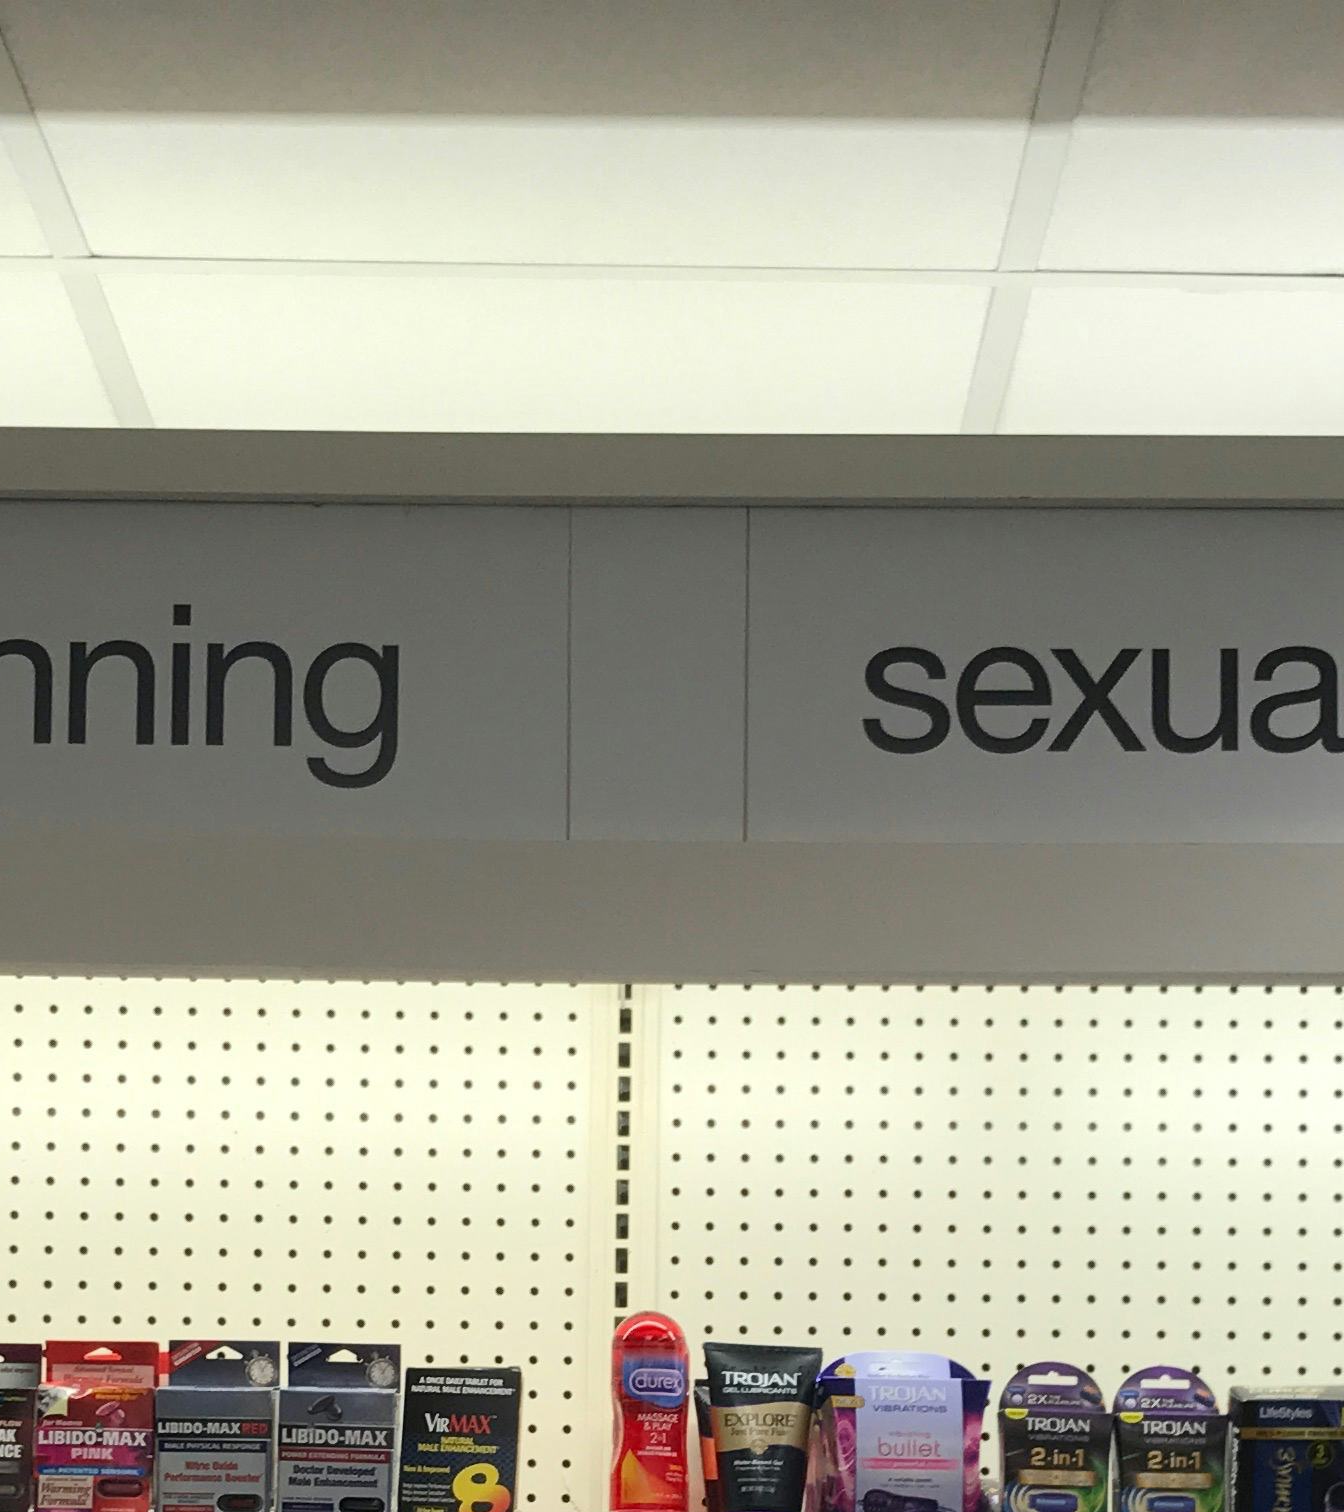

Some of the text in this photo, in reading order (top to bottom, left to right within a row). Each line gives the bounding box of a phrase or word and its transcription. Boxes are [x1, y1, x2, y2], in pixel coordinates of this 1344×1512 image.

[635, 1373, 683, 1390] durex
[721, 1371, 798, 1387] TROJAN
[869, 1386, 946, 1402] TROJAN
[872, 1404, 947, 1414] VIBRATIONS
[1259, 1407, 1313, 1420] LifeStyles
[725, 1413, 794, 1428] EXPLORE
[1026, 1417, 1090, 1434] TROJAN
[1141, 1420, 1206, 1436] TROJAN
[38, 1431, 146, 1446] LIBIDO-MAX
[281, 1428, 387, 1447] LIBIDO-MAX
[71, 1448, 114, 1460] PINK
[878, 1439, 941, 1458] bullet
[292, 1465, 376, 1477] Doctor Developed
